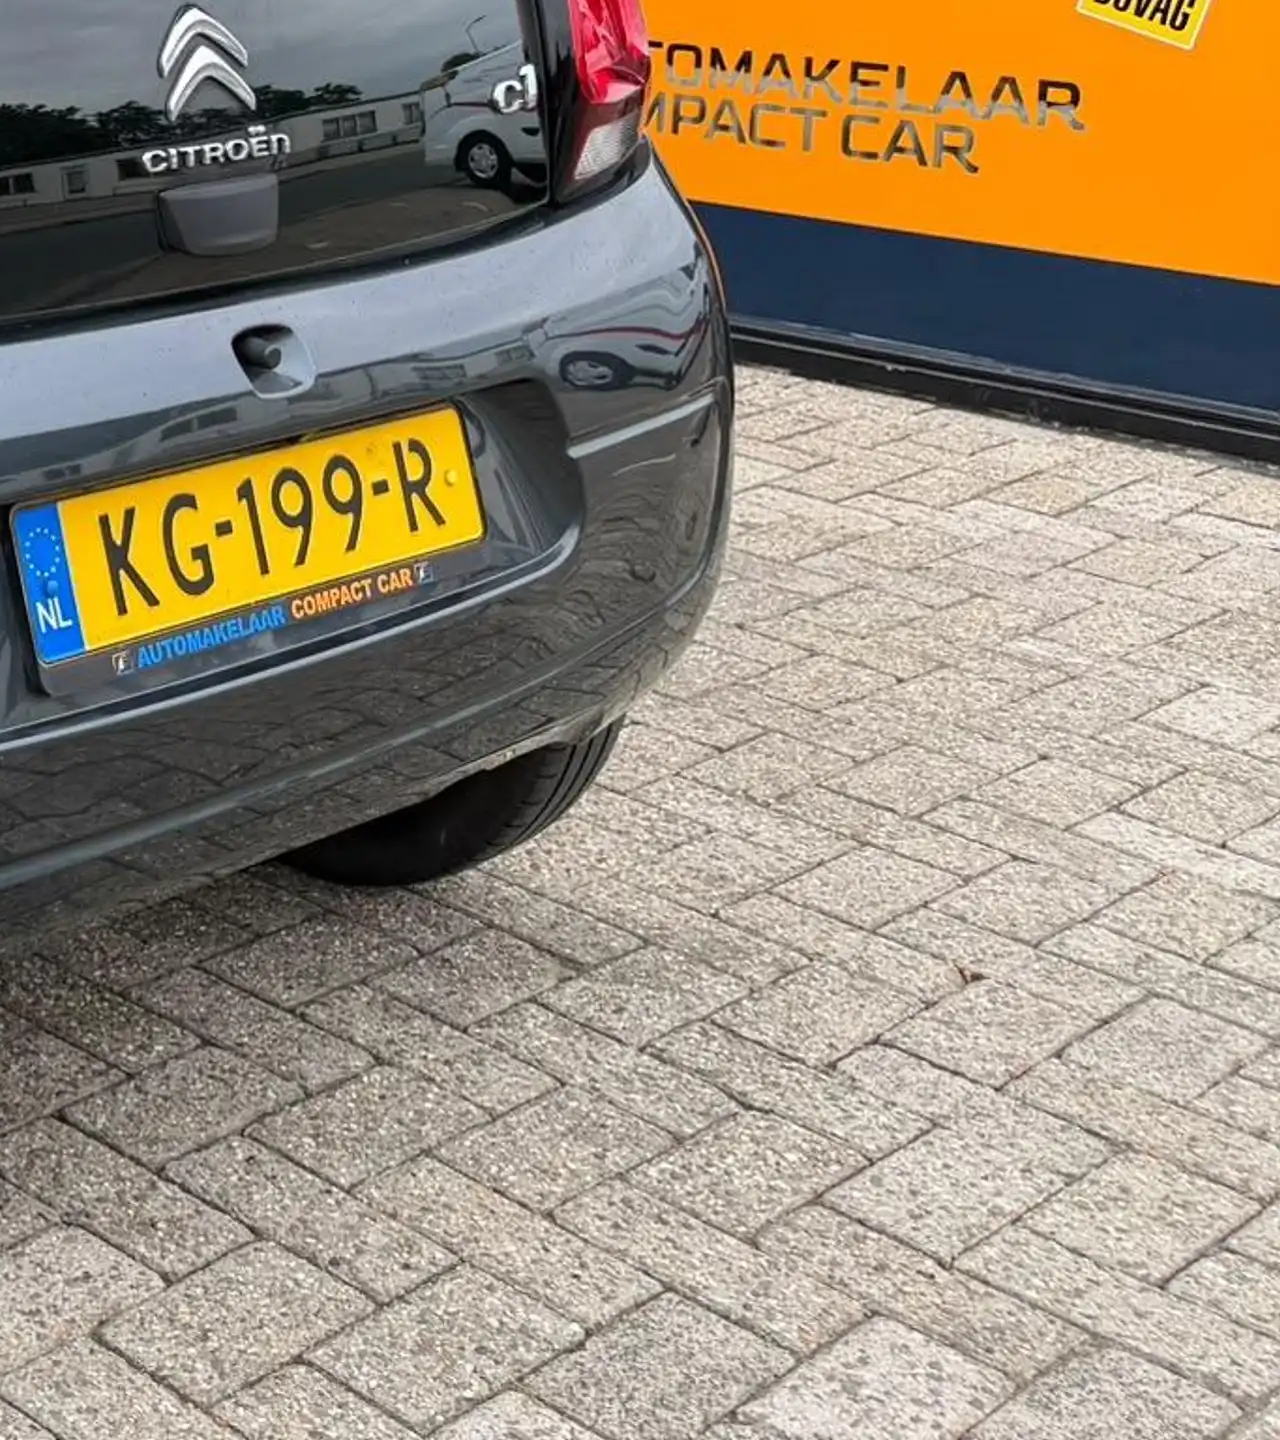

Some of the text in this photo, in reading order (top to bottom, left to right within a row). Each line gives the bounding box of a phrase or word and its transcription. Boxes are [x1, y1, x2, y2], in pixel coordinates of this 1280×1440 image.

[841, 112, 980, 175] CAR
[97, 437, 446, 616] KG-199-R
[36, 593, 72, 633] NL
[138, 569, 414, 669] AUTOMAKELAAR COMPACT CAR
